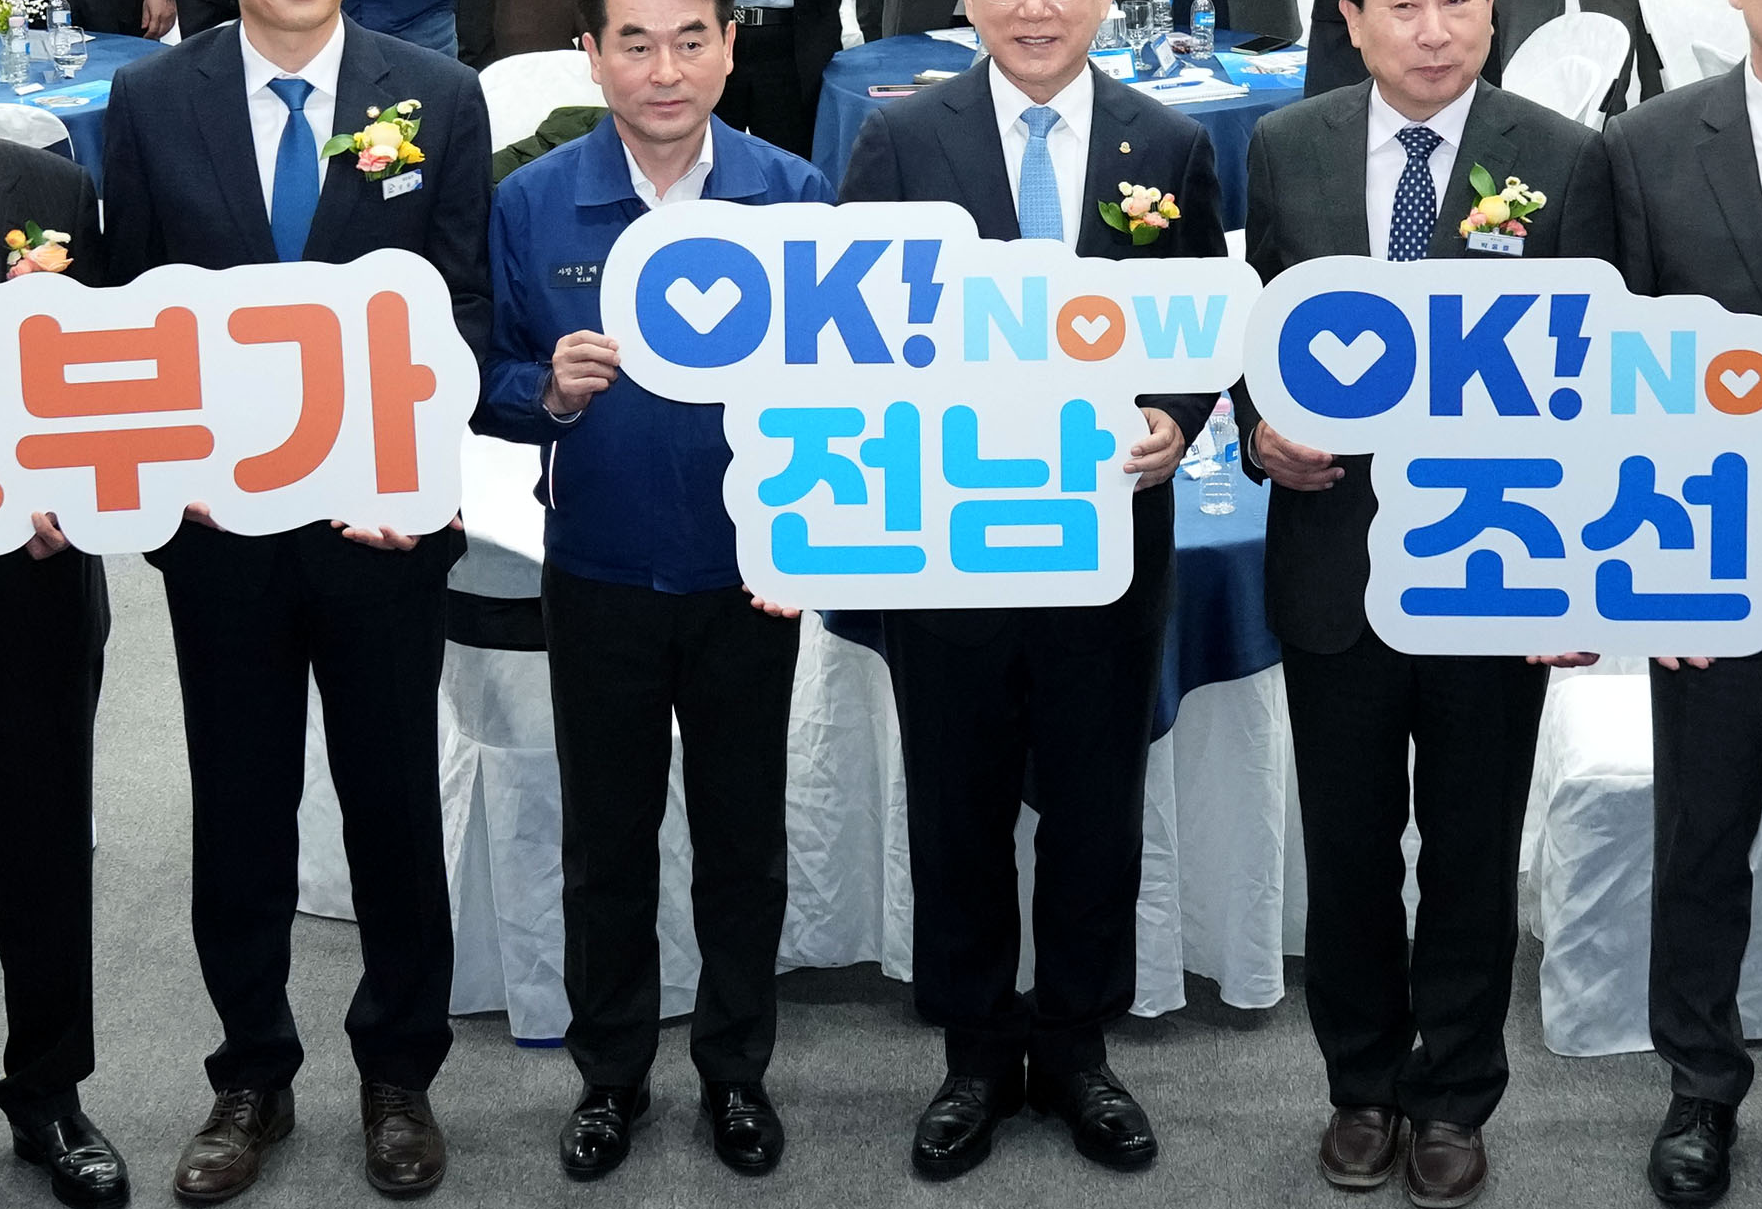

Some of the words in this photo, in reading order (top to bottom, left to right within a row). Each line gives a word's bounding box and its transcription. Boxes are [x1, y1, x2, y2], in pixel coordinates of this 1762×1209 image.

[575, 266, 584, 276] 김
[636, 238, 944, 369] OK!
[1279, 291, 1591, 421] OK!
[757, 399, 1116, 576] 전남
[1400, 452, 1751, 621] 조선
